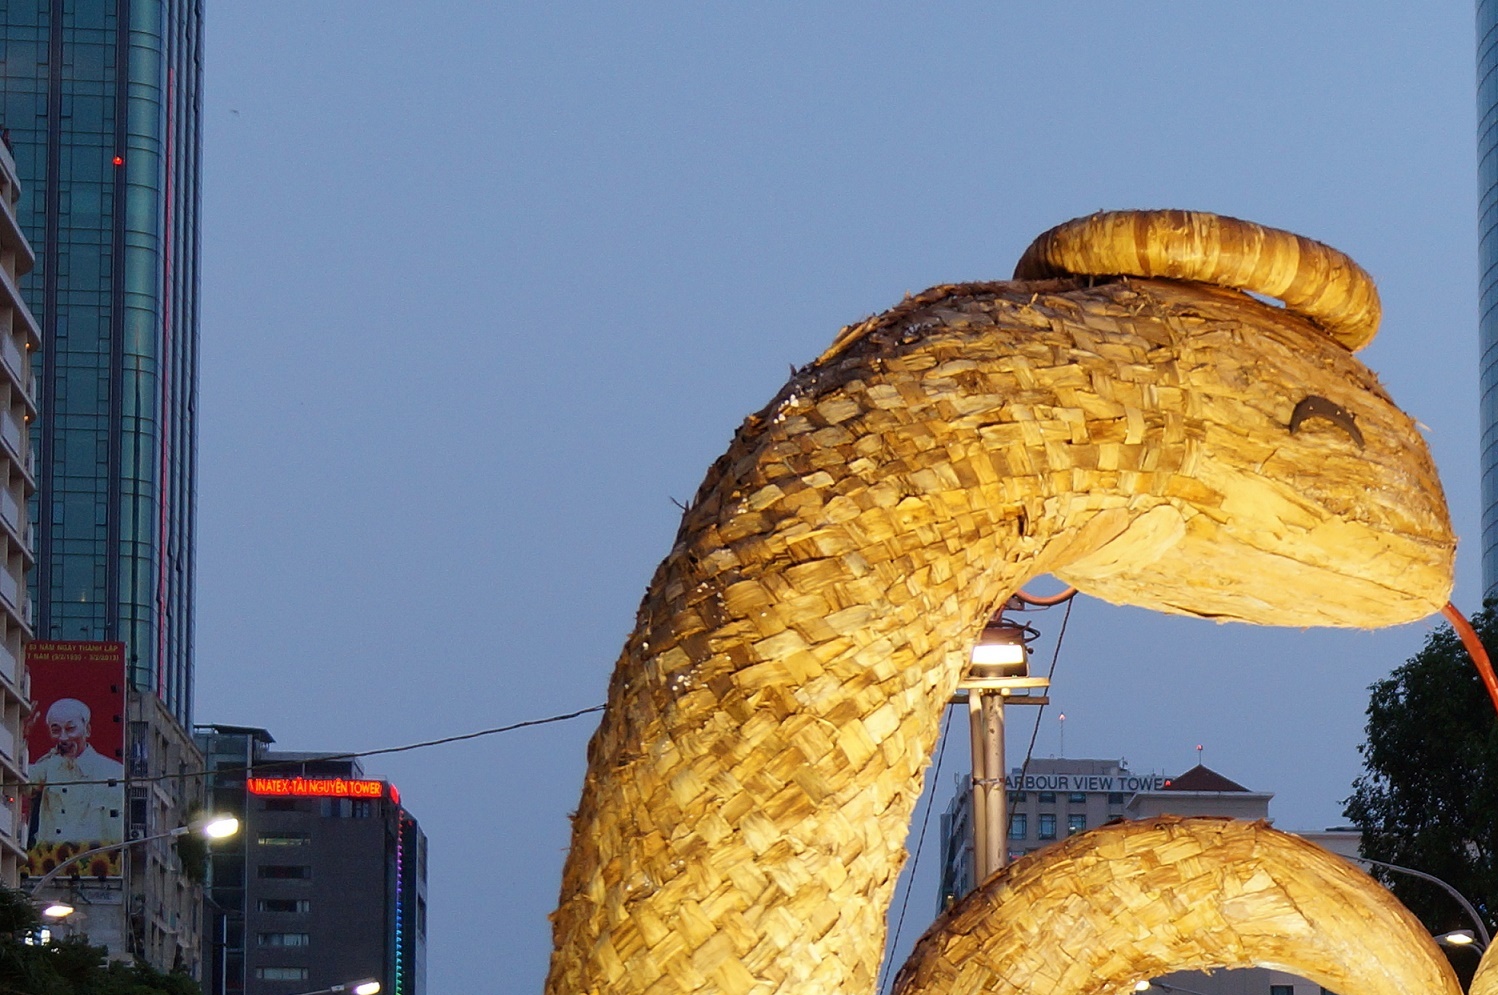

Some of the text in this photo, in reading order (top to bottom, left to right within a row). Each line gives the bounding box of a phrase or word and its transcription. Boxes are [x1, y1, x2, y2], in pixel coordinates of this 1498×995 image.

[309, 778, 348, 794] NGUYÊN
[350, 780, 382, 795] TOWER
[1004, 776, 1069, 790] ARBOUR
[1073, 777, 1113, 790] VIEW
